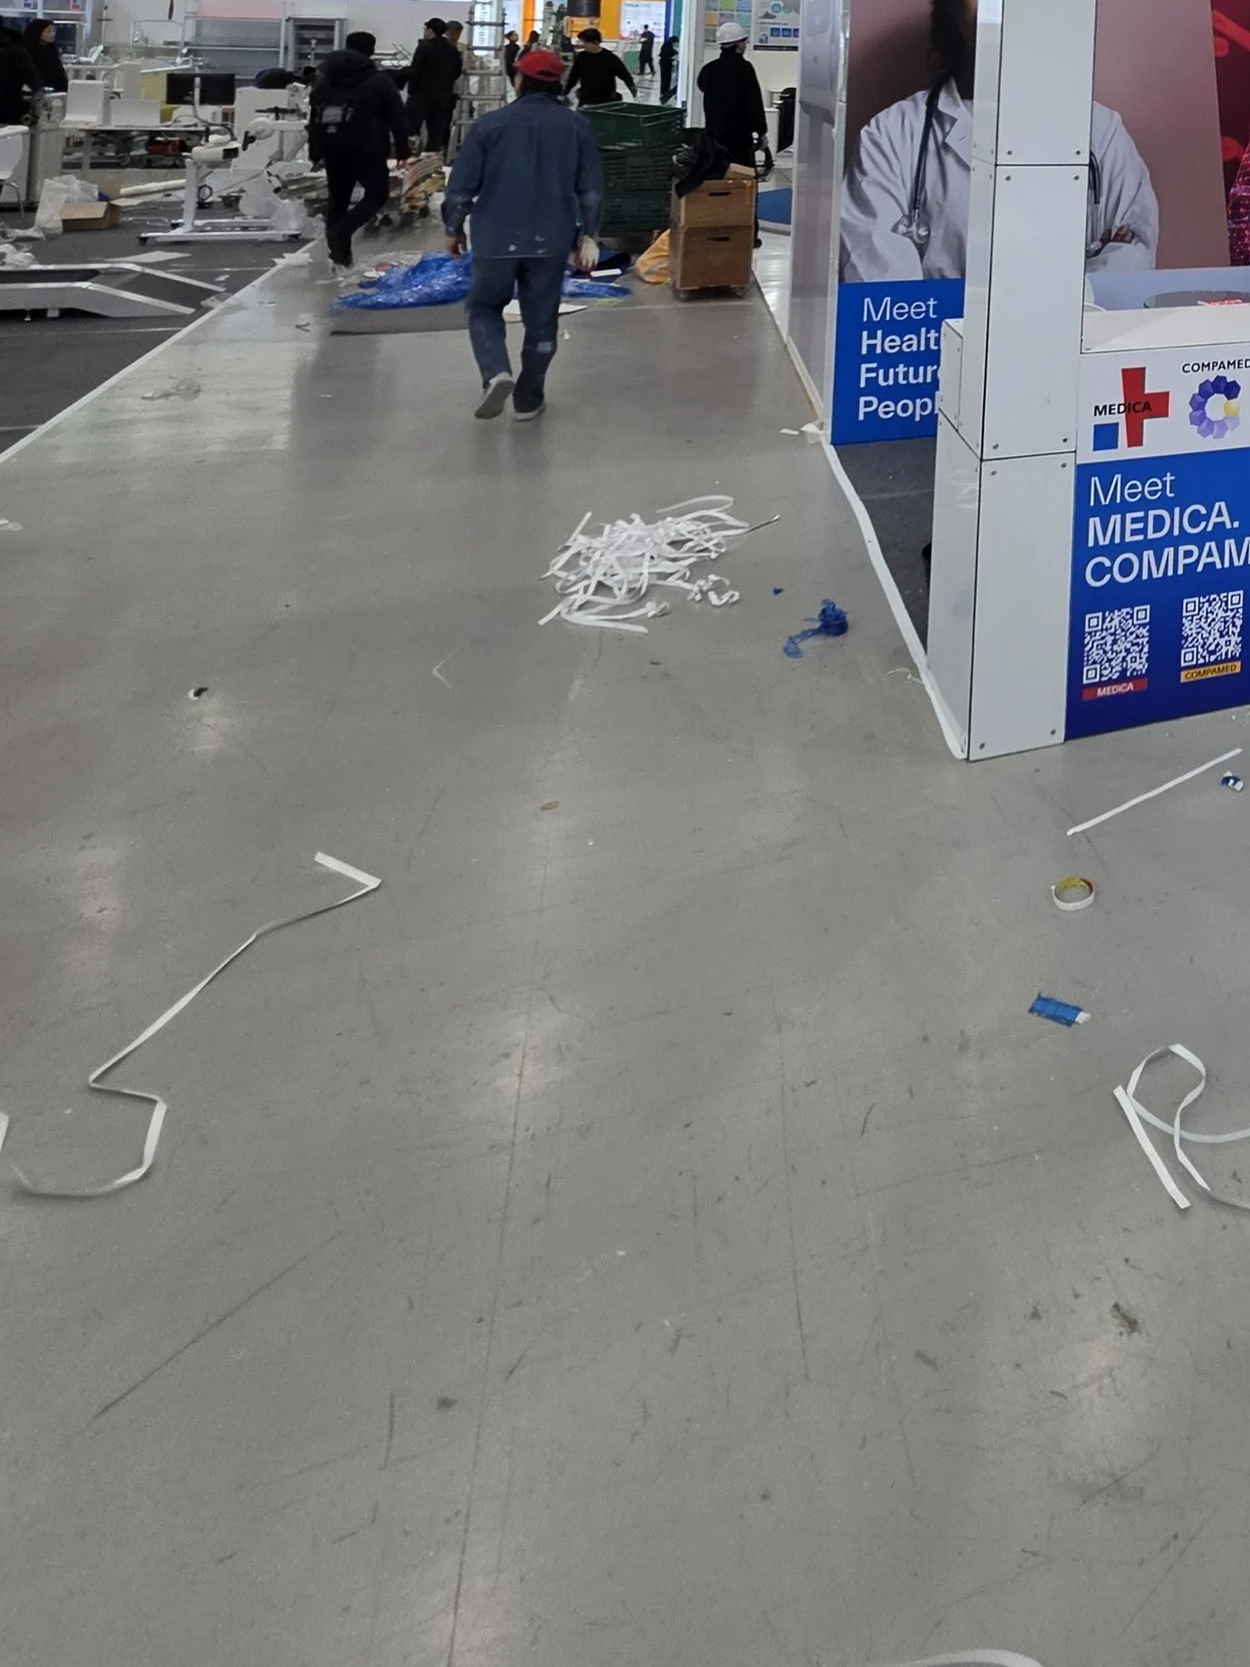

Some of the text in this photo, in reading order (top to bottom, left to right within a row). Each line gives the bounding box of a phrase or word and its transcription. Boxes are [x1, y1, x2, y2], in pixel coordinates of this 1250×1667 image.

[862, 296, 938, 322] Meet
[859, 362, 940, 388] Futur
[1093, 401, 1152, 417] MEDICA
[1089, 471, 1176, 507] Meet
[1087, 500, 1240, 548] MEDICA.
[1184, 664, 1237, 680] COMPAMED
[1096, 682, 1134, 698] MEDICA
